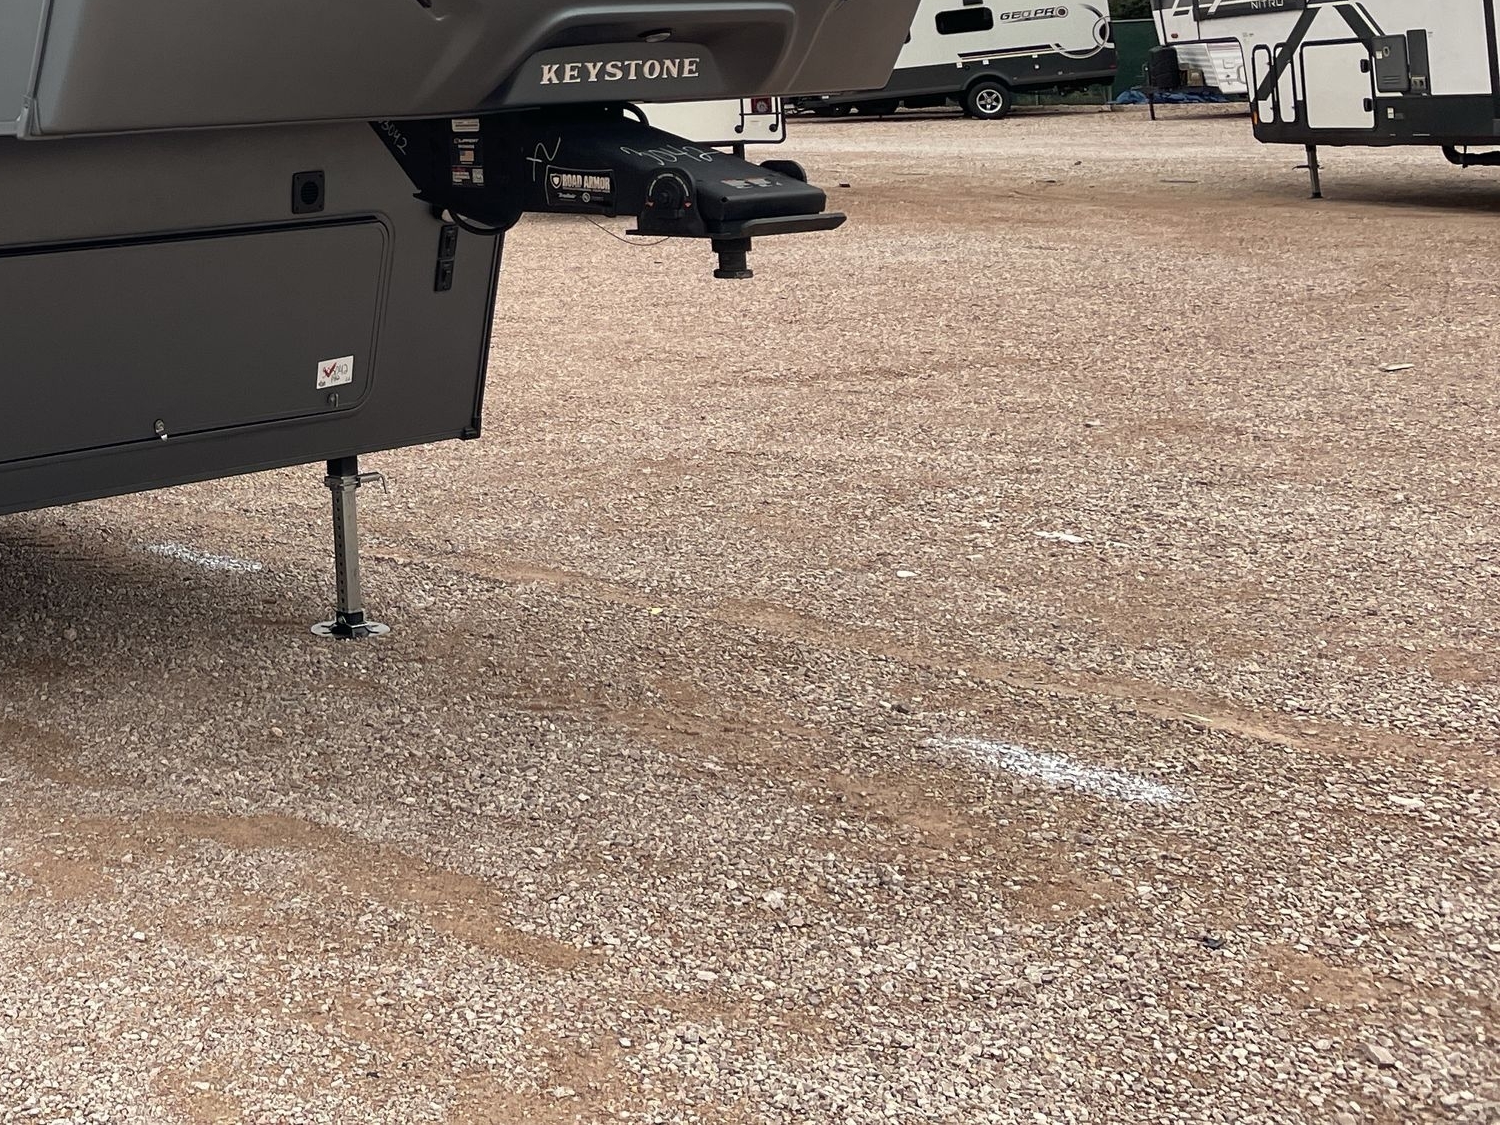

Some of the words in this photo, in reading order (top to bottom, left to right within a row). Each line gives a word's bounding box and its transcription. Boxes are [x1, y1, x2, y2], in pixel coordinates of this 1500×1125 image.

[1000, 9, 1032, 21] GEO
[540, 58, 700, 85] KEYSTONE
[562, 174, 582, 187] ROAD
[584, 176, 611, 191] ARMOR
